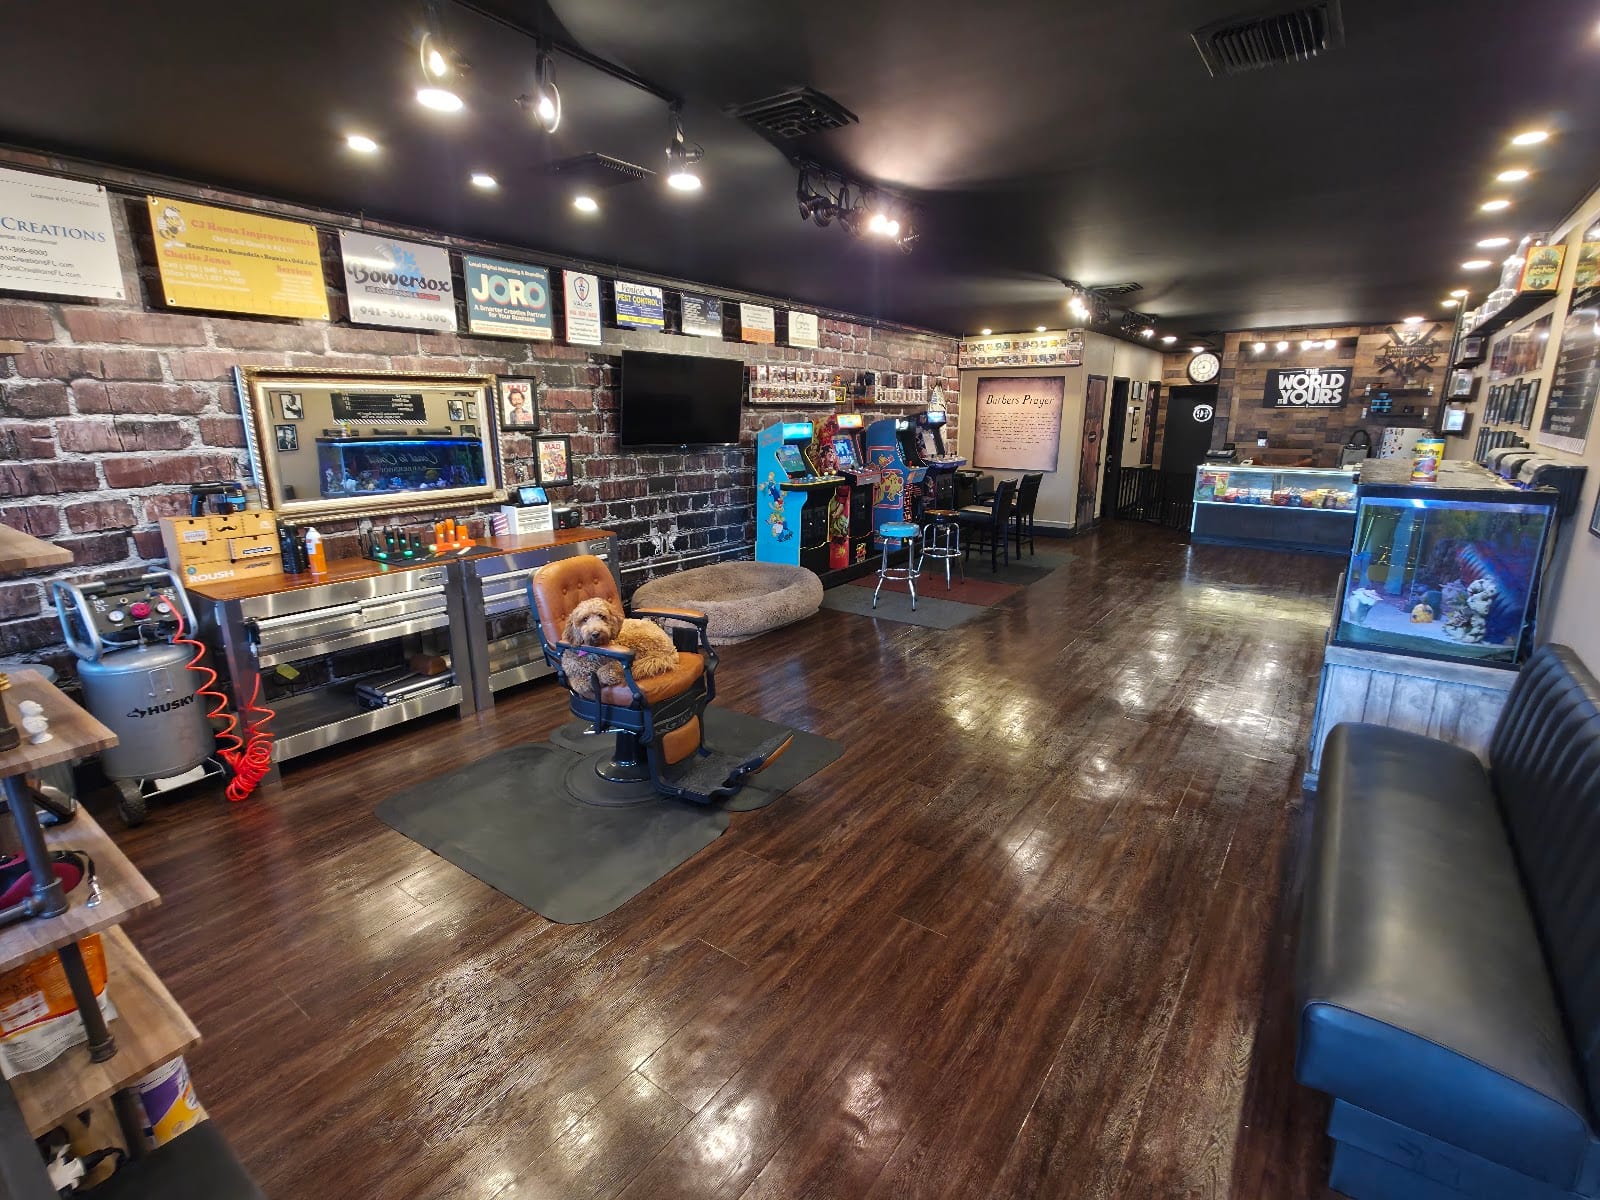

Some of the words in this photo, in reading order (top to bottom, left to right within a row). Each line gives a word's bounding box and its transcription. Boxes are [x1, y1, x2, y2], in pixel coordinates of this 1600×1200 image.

[0, 217, 106, 242] CREATIONS
[346, 262, 451, 292] Bowersox
[471, 273, 546, 310] JORO
[617, 293, 631, 302] PEST
[508, 383, 528, 392] MAD
[1279, 374, 1345, 390] WORLD
[986, 394, 1020, 405] Barbers
[1022, 394, 1055, 408] Prayer
[1280, 387, 1342, 404] YOURS
[189, 569, 234, 583] ROUSH
[147, 694, 194, 715] HUSKY
